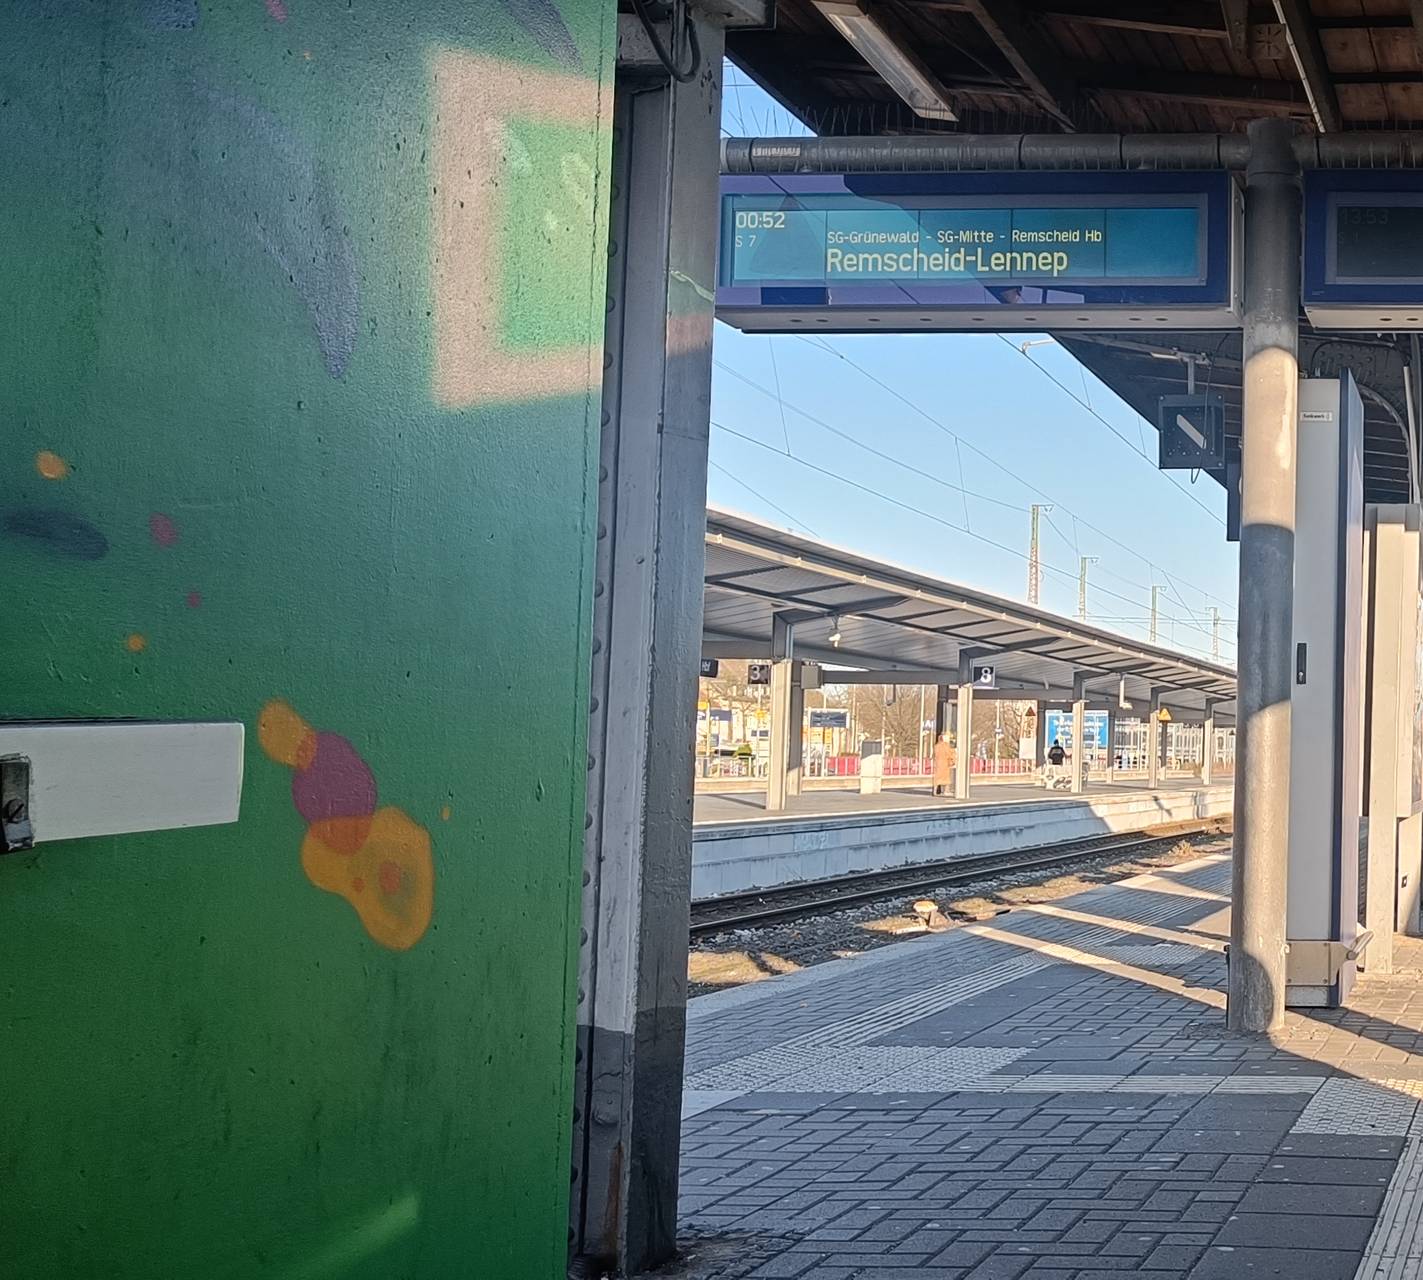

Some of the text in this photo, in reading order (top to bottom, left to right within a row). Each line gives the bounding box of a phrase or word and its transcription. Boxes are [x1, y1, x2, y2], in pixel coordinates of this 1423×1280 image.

[735, 211, 785, 229] 00:52
[735, 235, 757, 248] S 7
[827, 230, 919, 244] SG-Grünewald
[937, 230, 994, 243] SG-Mitte
[1012, 229, 1080, 243] Remscheid
[1085, 228, 1103, 243] Hb
[826, 248, 1068, 277] Remscheid-Lennep
[981, 667, 992, 683] 8
